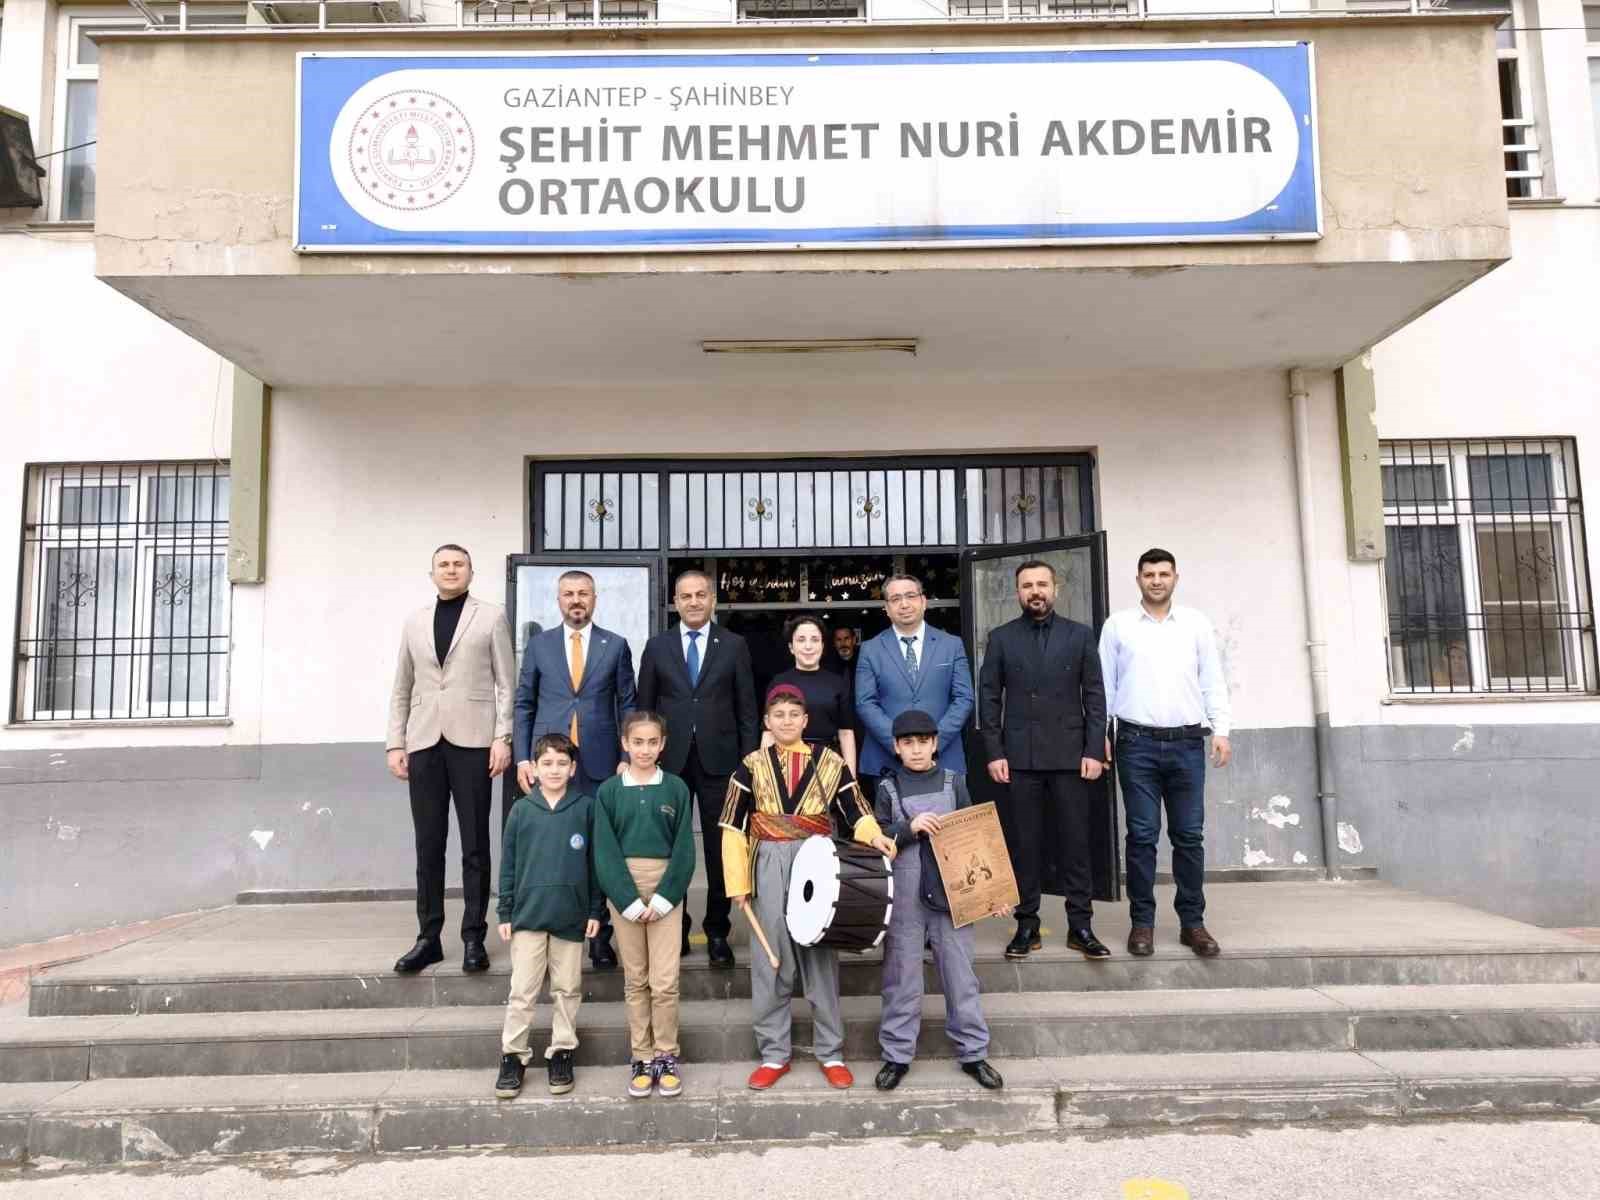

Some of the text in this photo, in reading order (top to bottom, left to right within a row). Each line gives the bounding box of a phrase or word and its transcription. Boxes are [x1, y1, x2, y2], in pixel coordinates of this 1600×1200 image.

[504, 84, 647, 108] GAZİANTEP
[669, 82, 794, 111] ŞAHİNBEY
[500, 108, 1272, 173] ŞEHİT MEHMET NURİ AKDEMİR
[498, 176, 805, 215] ORTAOKULU
